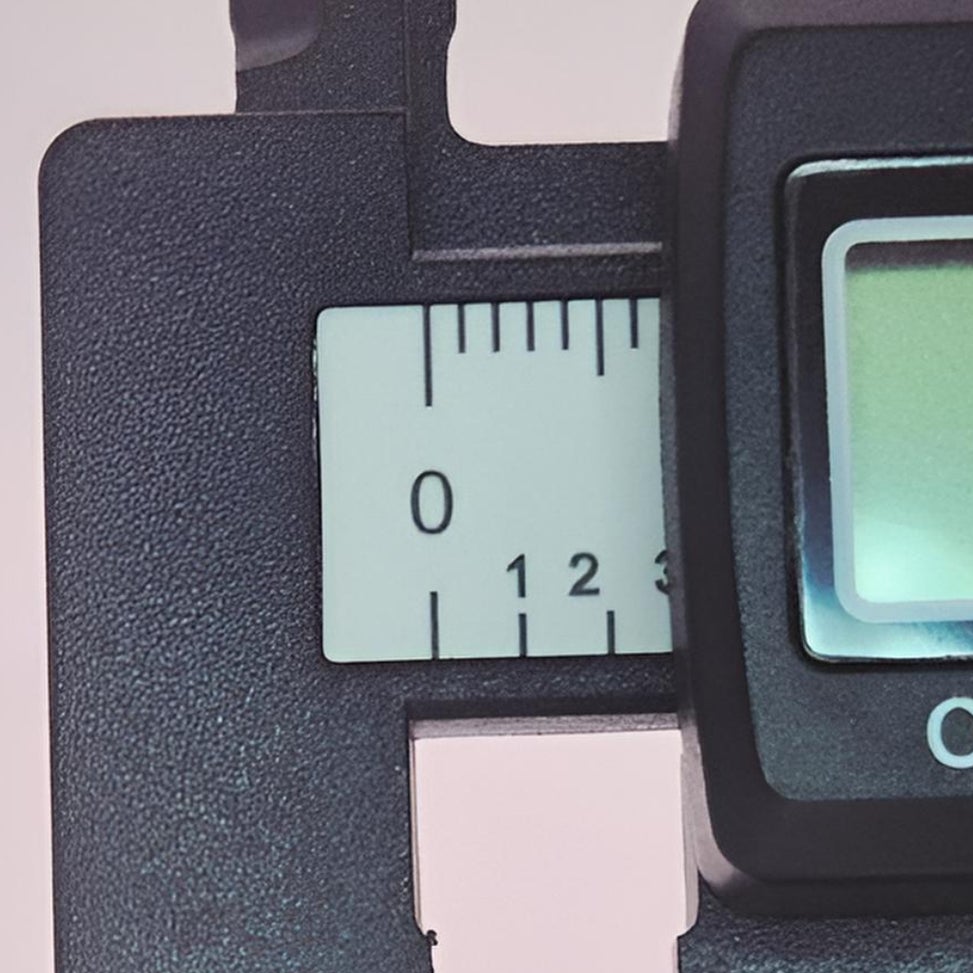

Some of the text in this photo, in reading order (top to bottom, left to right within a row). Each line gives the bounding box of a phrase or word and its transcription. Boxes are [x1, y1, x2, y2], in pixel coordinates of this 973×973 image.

[410, 470, 454, 534] 0
[506, 553, 528, 598] 1
[568, 551, 602, 596] 2
